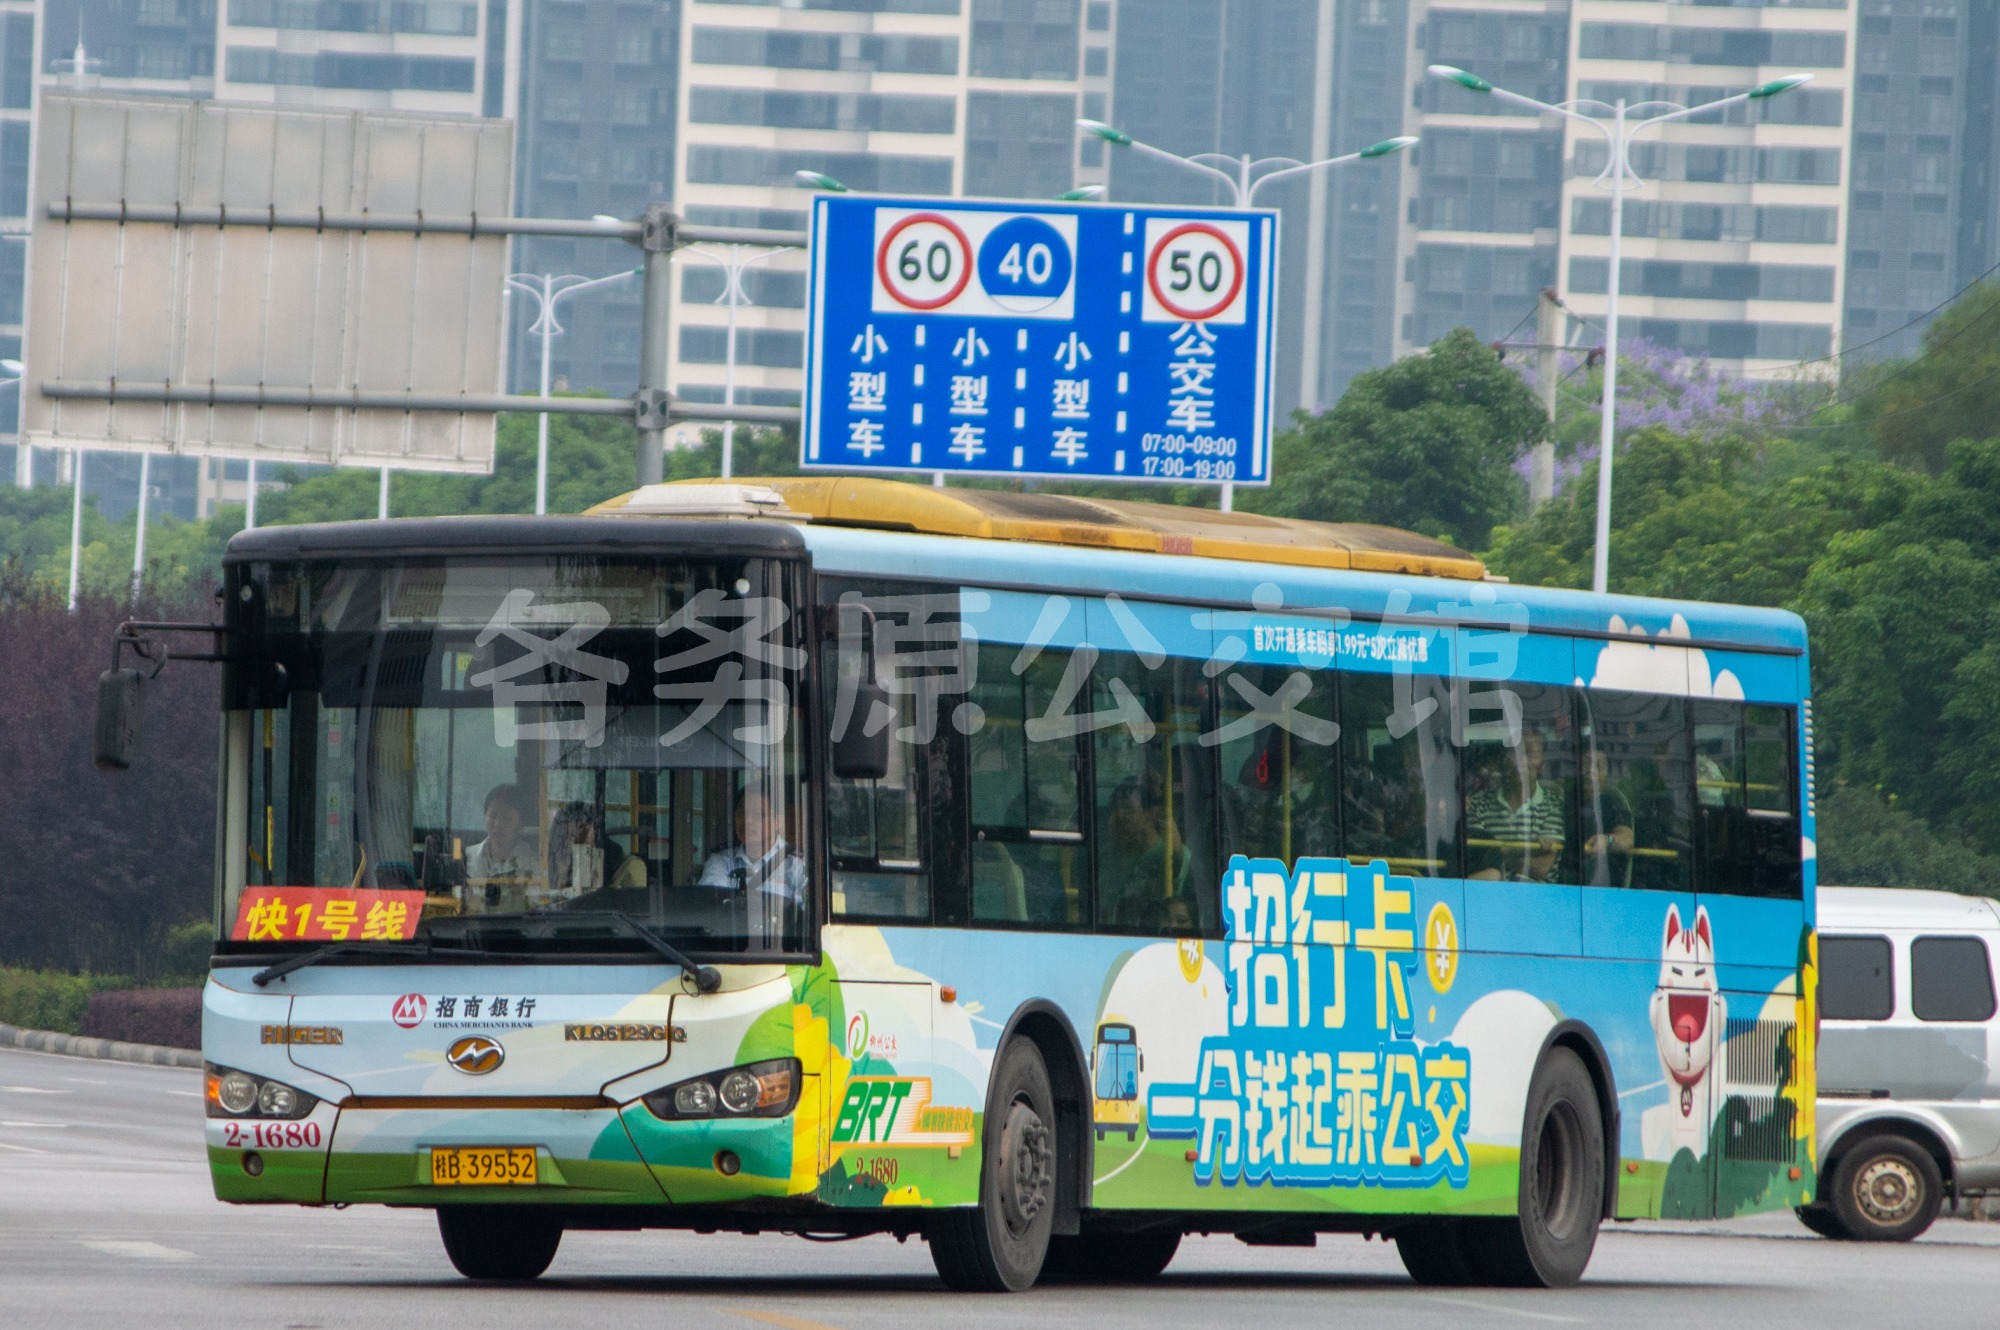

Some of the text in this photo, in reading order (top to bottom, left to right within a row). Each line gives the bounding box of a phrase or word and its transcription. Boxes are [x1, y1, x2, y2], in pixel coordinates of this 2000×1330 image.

[899, 240, 952, 283] 60
[998, 243, 1052, 285] 40
[1169, 250, 1222, 293] 50
[846, 324, 889, 458] 小型车
[948, 327, 990, 462] 小型车
[1050, 331, 1092, 466] 小型车
[1166, 321, 1218, 433] 公交车
[1141, 433, 1237, 457] 07:00-09:00
[1142, 457, 1236, 480] 17:00-19:00
[245, 897, 407, 940] 快1号线
[1226, 868, 1414, 1029] 招行卡
[261, 1025, 343, 1044] HIGER
[433, 1021, 534, 1029] CHINA MERCHANTS BANK
[831, 1082, 912, 1142] BRT
[1152, 1050, 1467, 1167] 一分钱起乘公交
[224, 1121, 321, 1150] 2-1680
[856, 1157, 898, 1185] 2-1680
